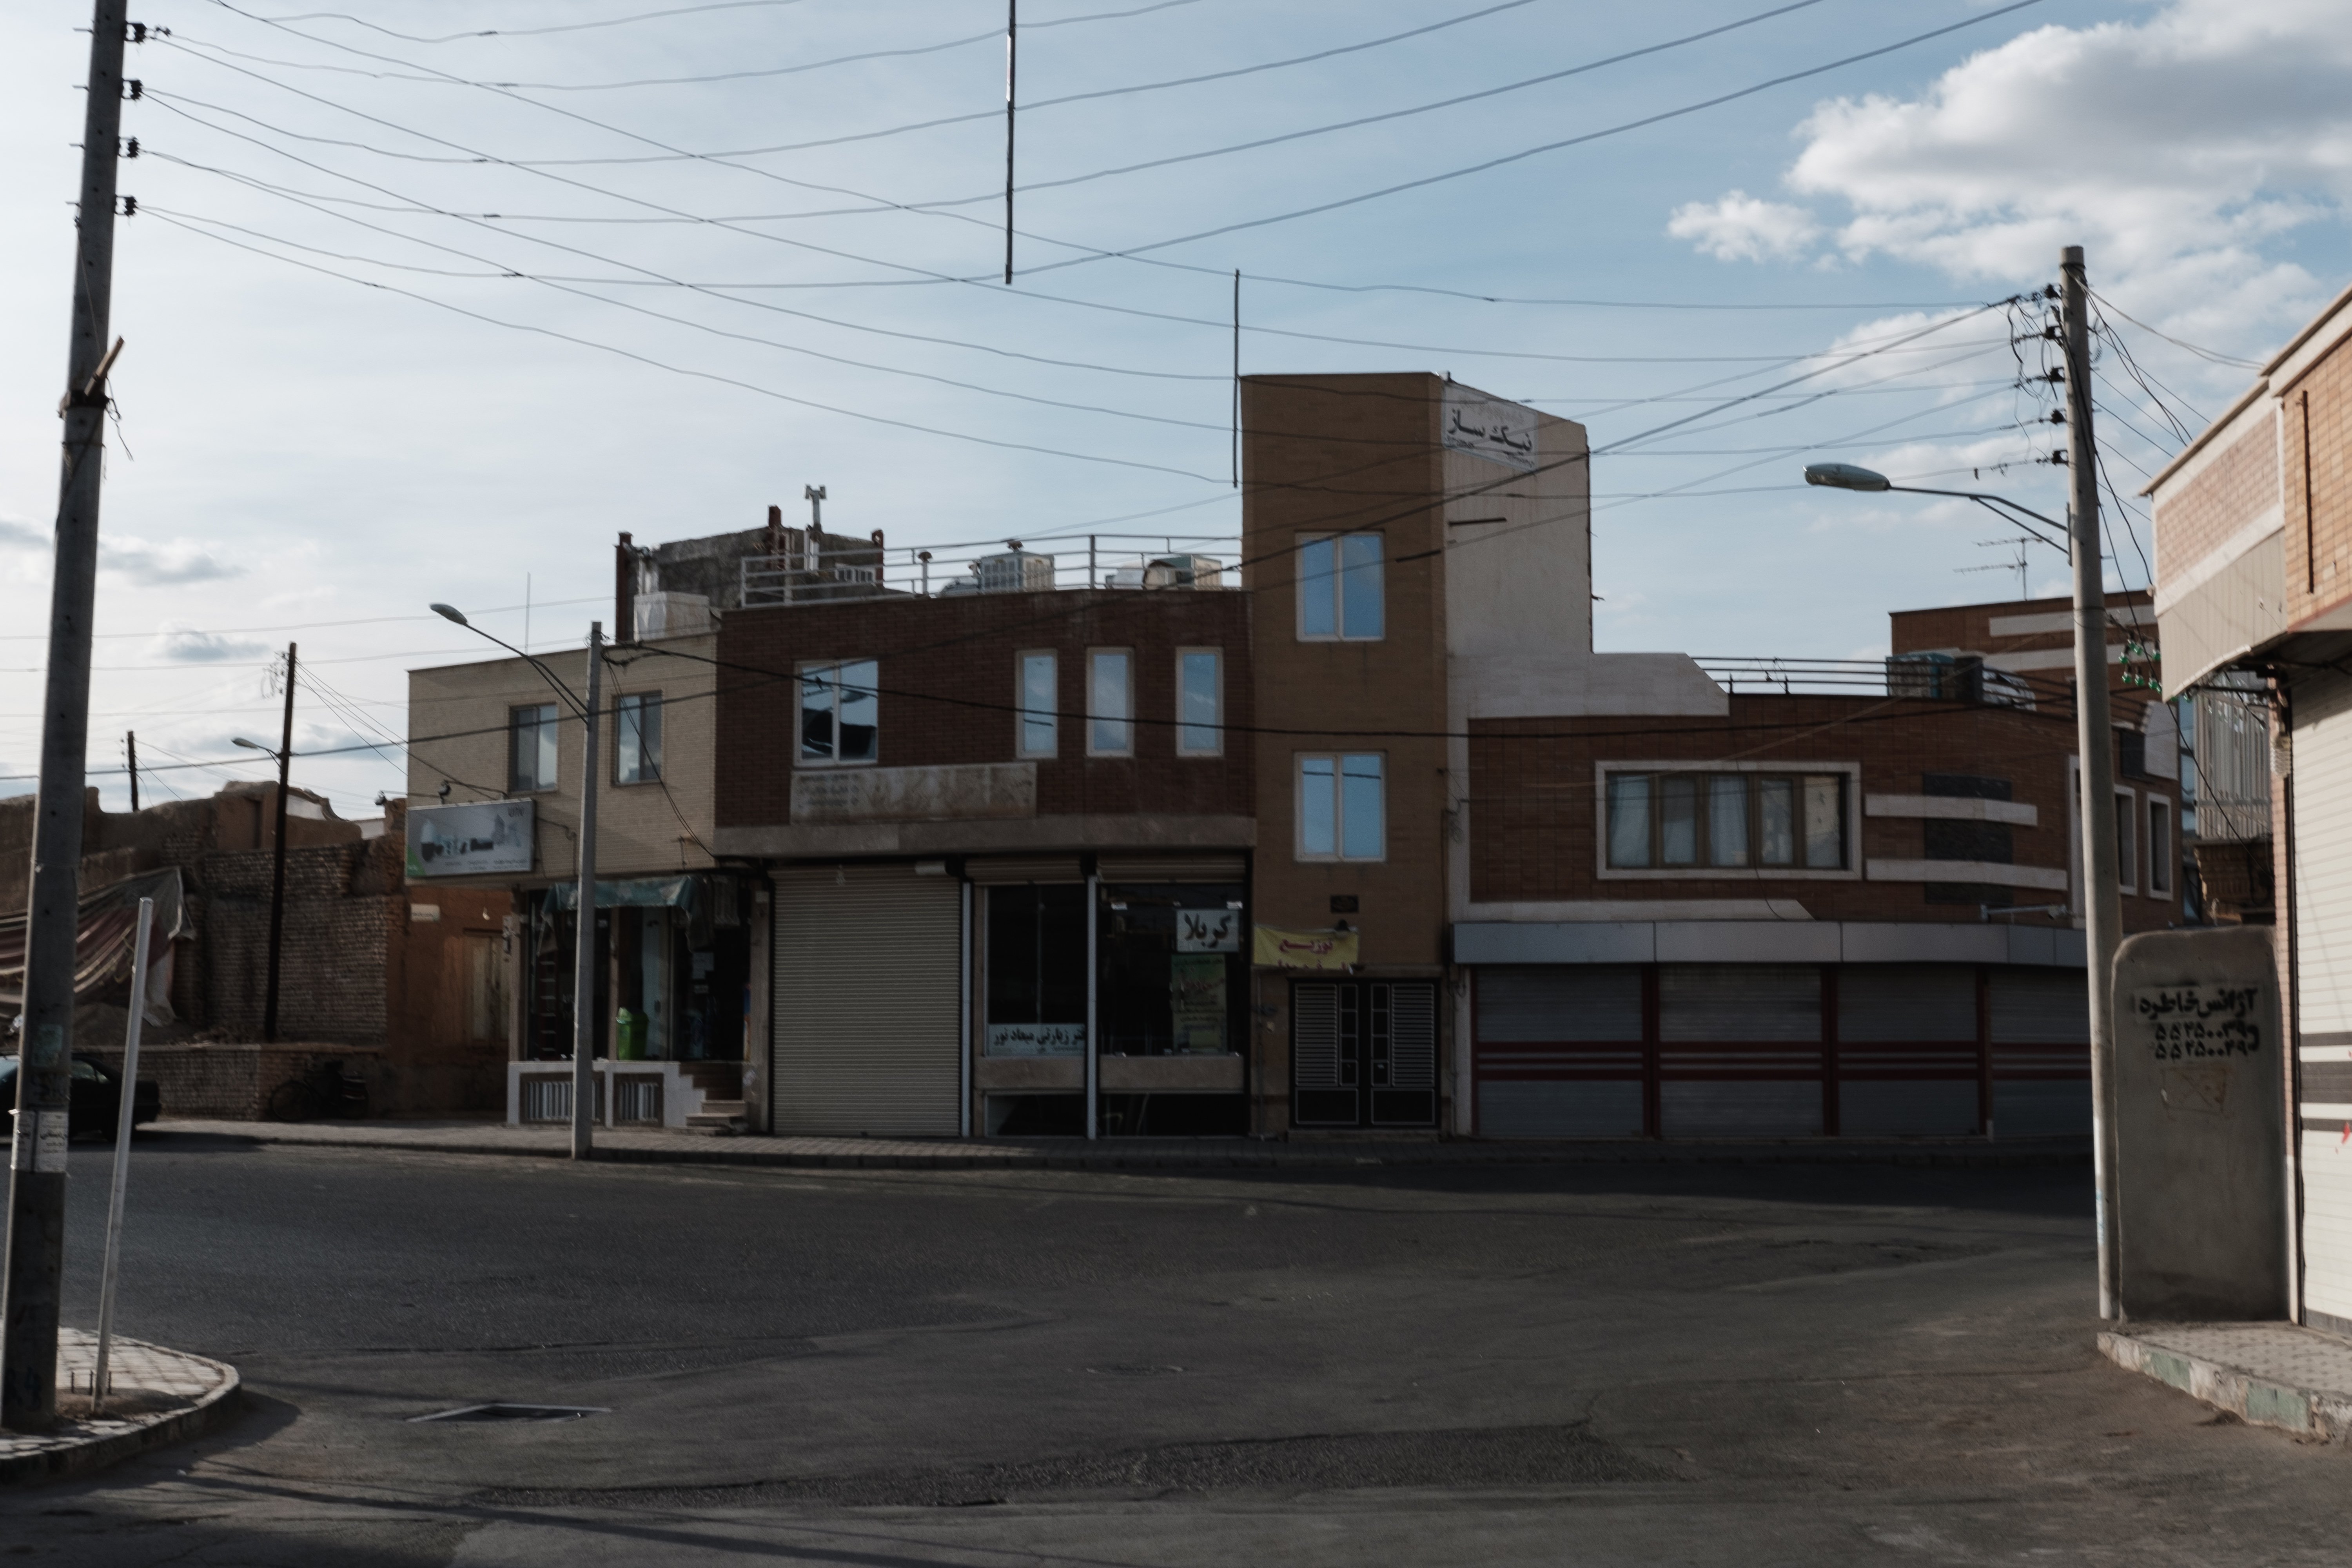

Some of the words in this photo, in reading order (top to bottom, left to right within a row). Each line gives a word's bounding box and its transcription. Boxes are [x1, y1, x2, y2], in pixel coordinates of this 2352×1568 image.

[1447, 408, 1485, 437] ساز
[1489, 425, 1532, 456] نیک
[1184, 913, 1231, 949] کربلا
[1279, 937, 1333, 955] توزیع
[2139, 990, 2198, 1020] خاطره
[2198, 987, 2258, 1018] آژانس
[994, 1027, 1008, 1045] نور
[1037, 1027, 1069, 1045] زیارتی
